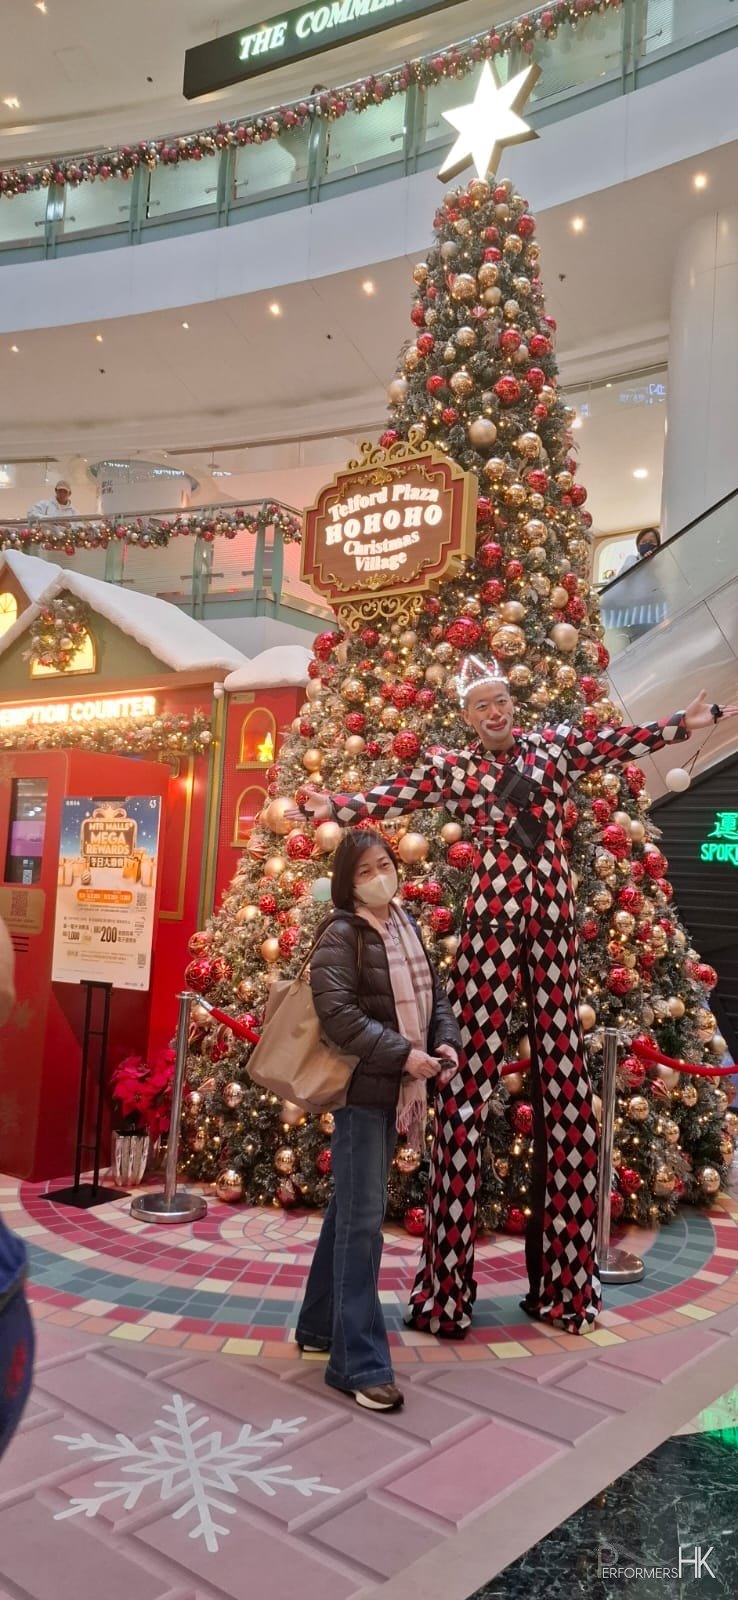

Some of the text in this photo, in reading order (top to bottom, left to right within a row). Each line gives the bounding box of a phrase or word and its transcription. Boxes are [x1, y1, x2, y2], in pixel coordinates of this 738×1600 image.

[239, 0, 406, 60] THE COMME
[328, 483, 440, 523] Telford Plaza
[344, 531, 421, 557] Christmas
[355, 551, 408, 572] Village
[71, 696, 156, 721] COUNTER
[86, 844, 130, 855] REWARDS
[90, 832, 126, 844] MEGA
